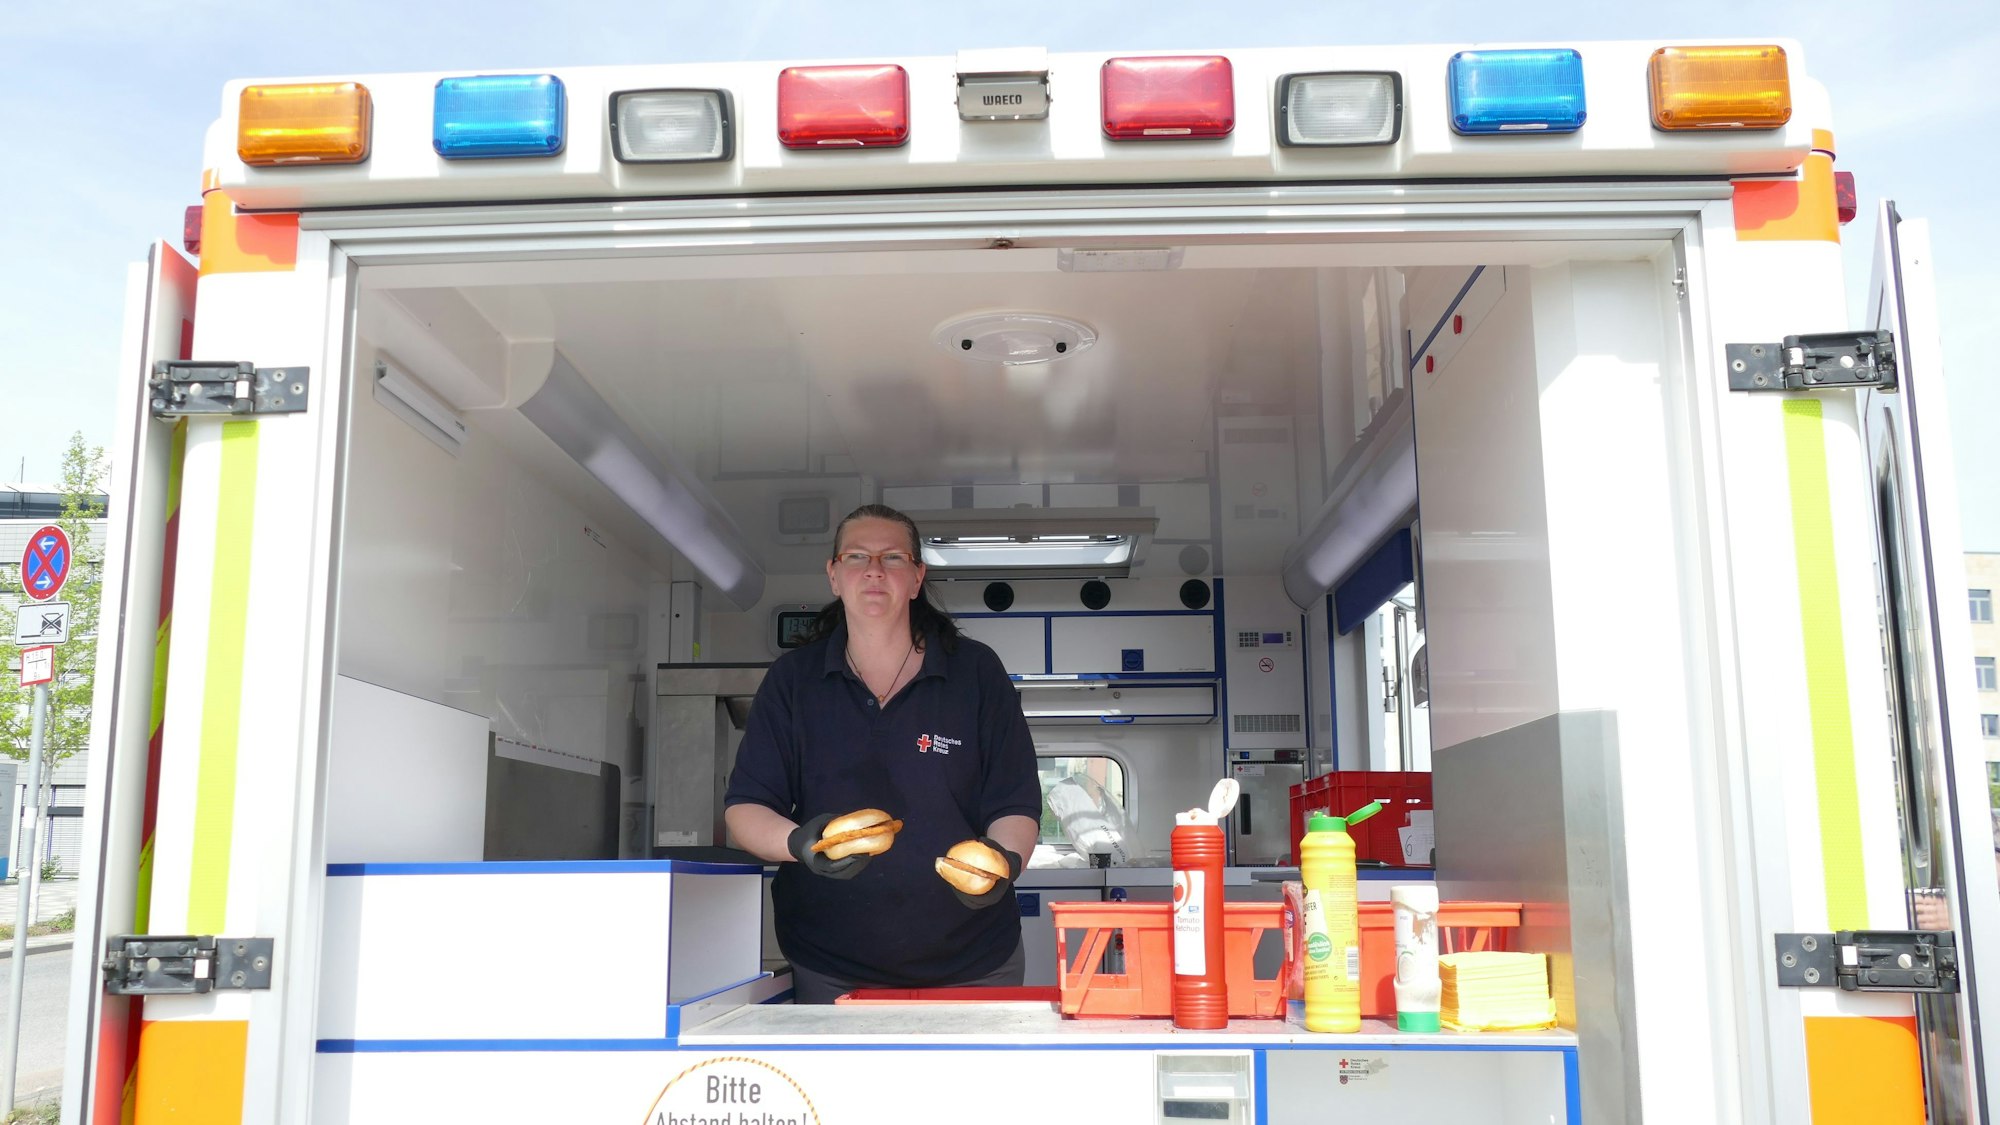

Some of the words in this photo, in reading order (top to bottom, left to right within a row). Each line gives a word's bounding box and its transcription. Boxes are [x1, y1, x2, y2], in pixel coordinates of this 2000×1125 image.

[983, 94, 1023, 105] WAECO
[933, 734, 962, 745] Deutsches
[933, 740, 949, 749] Rotes
[932, 746, 949, 754] Kreuz
[1405, 834, 1413, 857] 6
[1177, 916, 1200, 924] Tomato
[1175, 924, 1200, 934] Ketchup
[706, 1075, 761, 1104] Bitte
